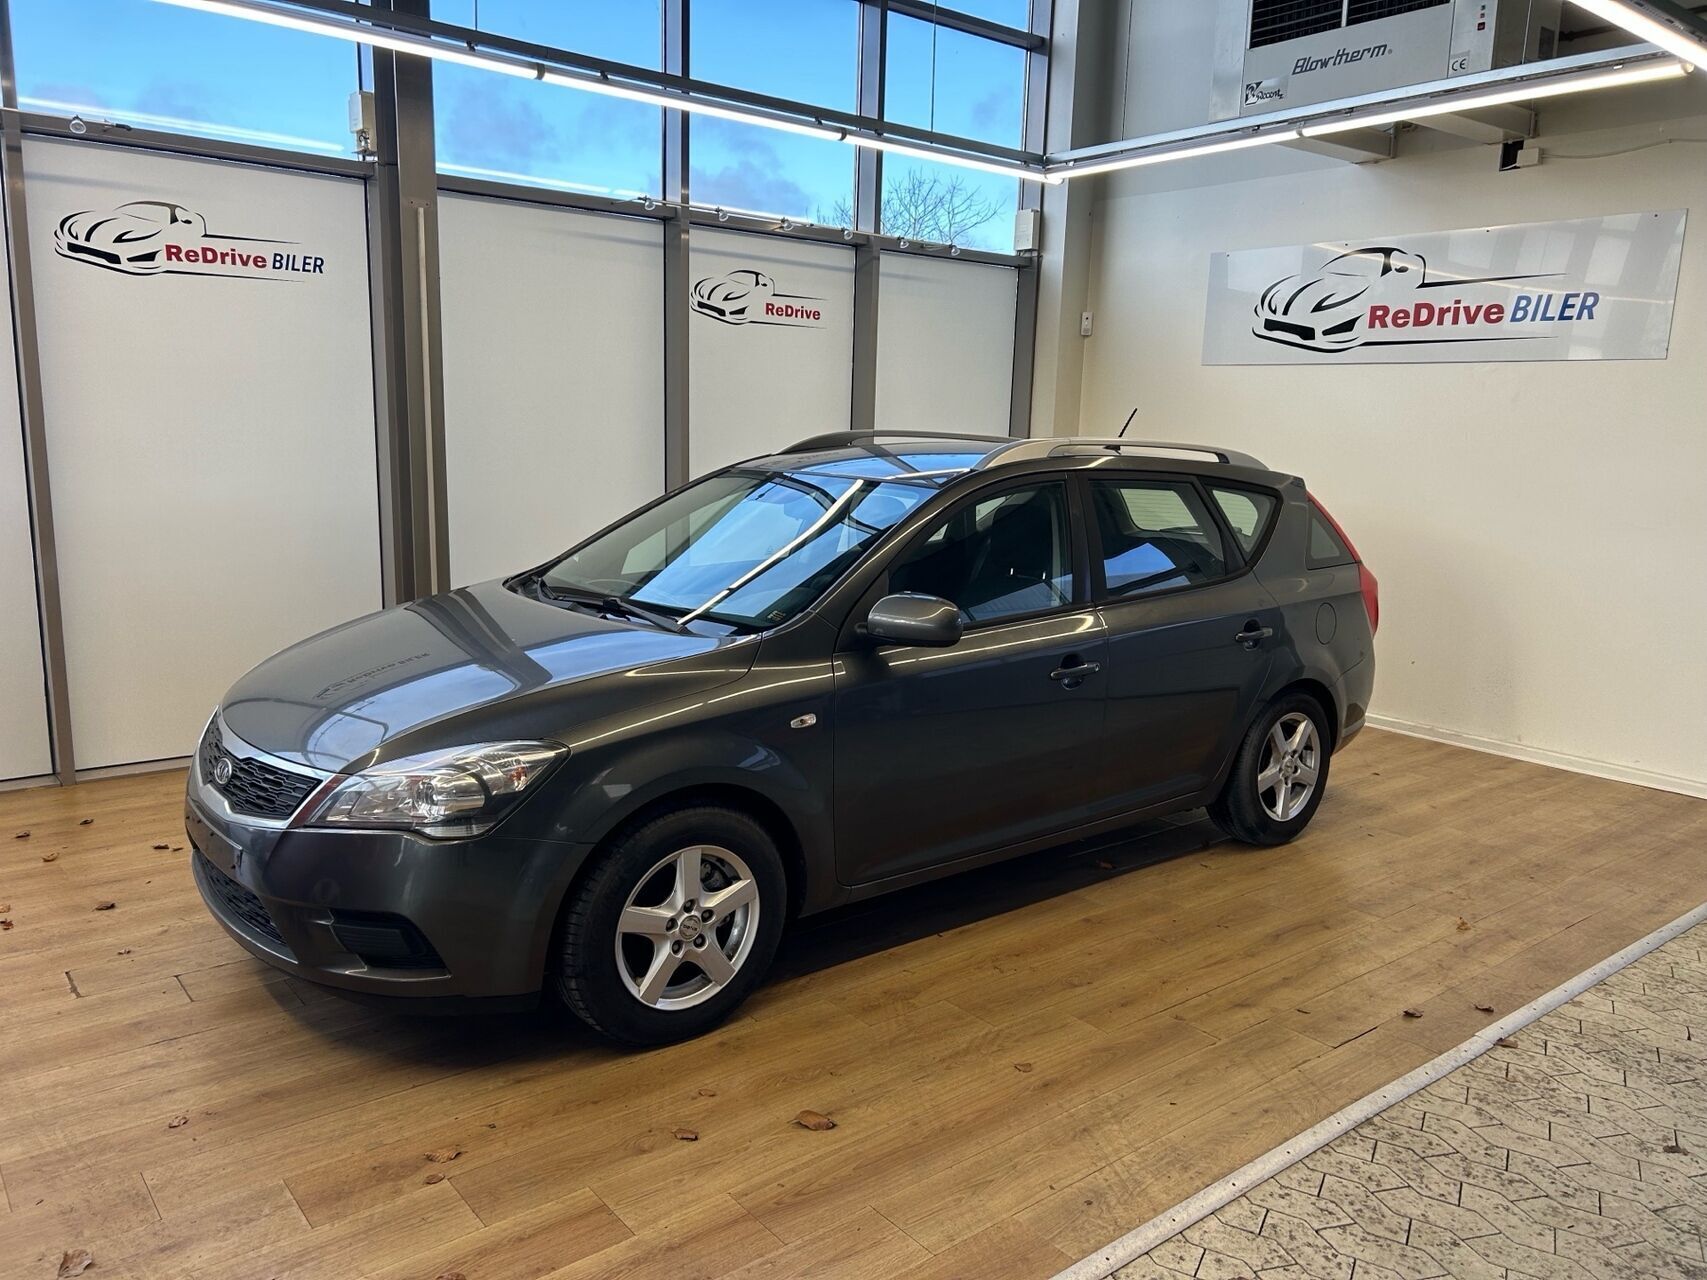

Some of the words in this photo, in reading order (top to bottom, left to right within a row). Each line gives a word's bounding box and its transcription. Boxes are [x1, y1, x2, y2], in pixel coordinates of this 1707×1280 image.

[1291, 44, 1388, 75] Blowtherm
[164, 243, 268, 269] ReDrive
[271, 252, 325, 274] BILER
[765, 302, 821, 321] ReDrive
[1367, 299, 1505, 329] ReDrive
[1509, 292, 1600, 323] BILER
